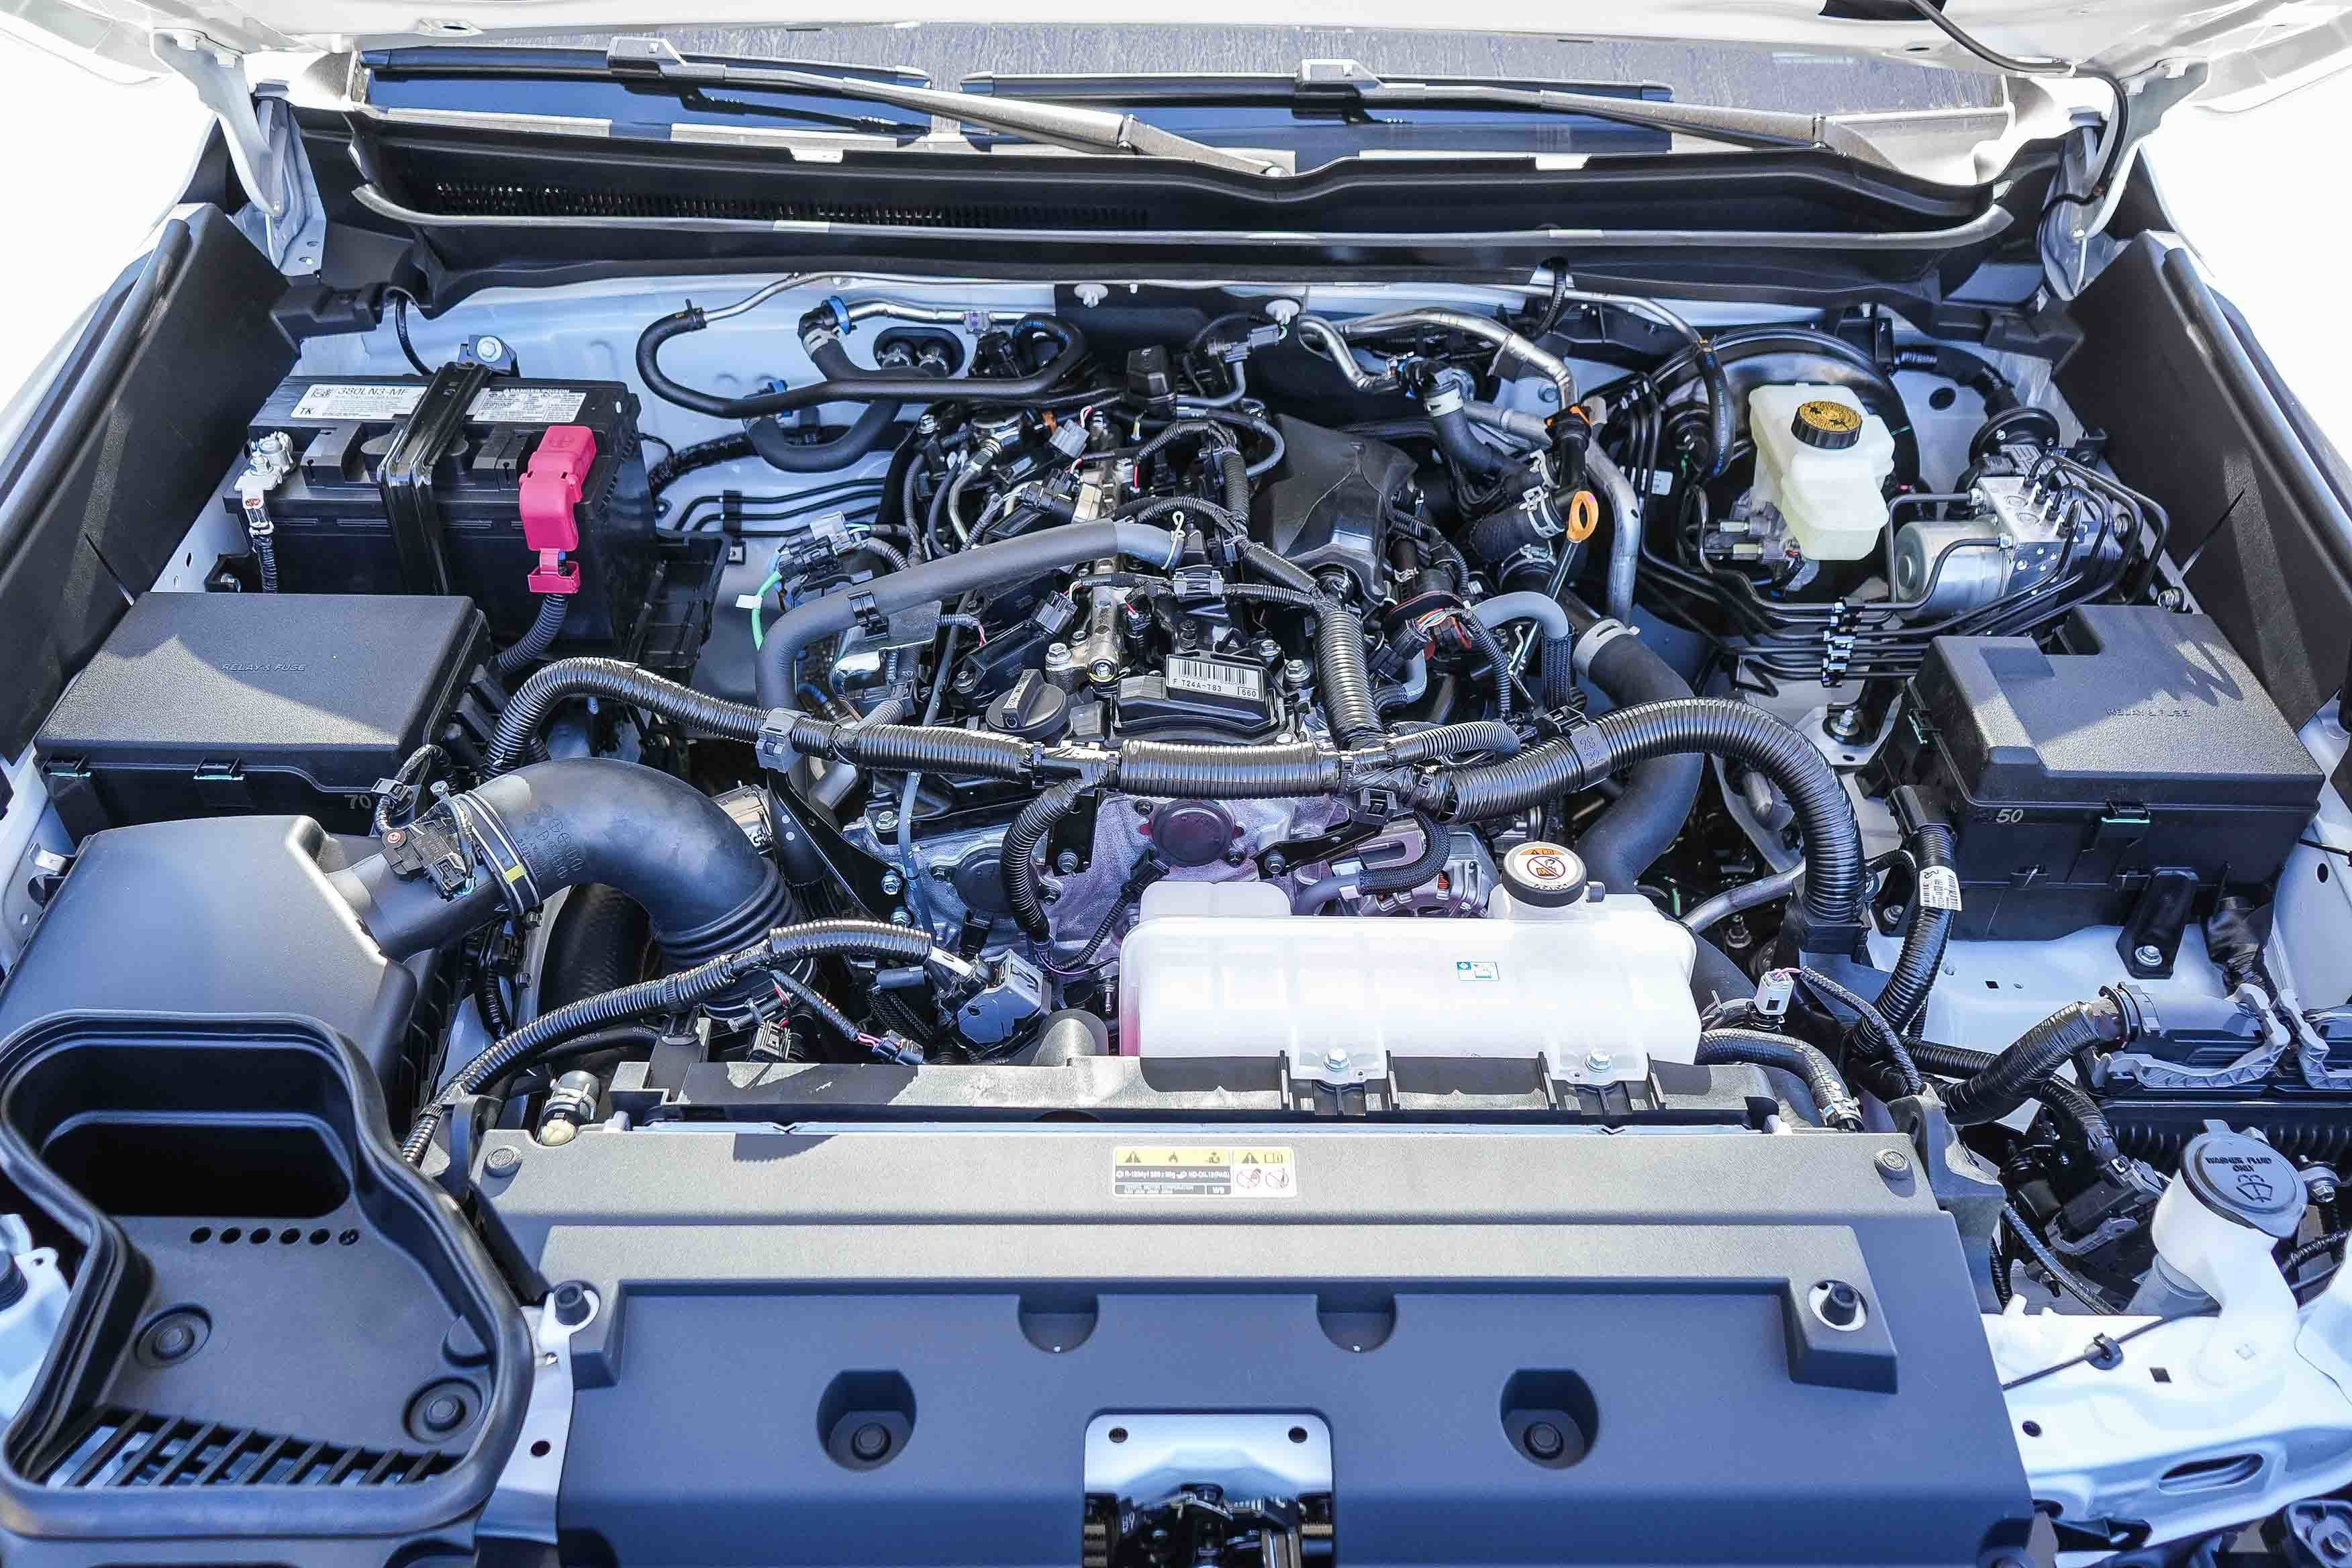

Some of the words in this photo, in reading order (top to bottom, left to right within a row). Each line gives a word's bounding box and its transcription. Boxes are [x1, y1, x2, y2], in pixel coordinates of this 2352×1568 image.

[221, 663, 261, 672] RELAY
[274, 663, 307, 672] FUSE
[344, 794, 373, 810] 70
[1996, 808, 2024, 824] 50
[2205, 1157, 2244, 1165] WASHER
[2246, 1157, 2272, 1165] FLUID
[2232, 1165, 2255, 1173] ONLY
